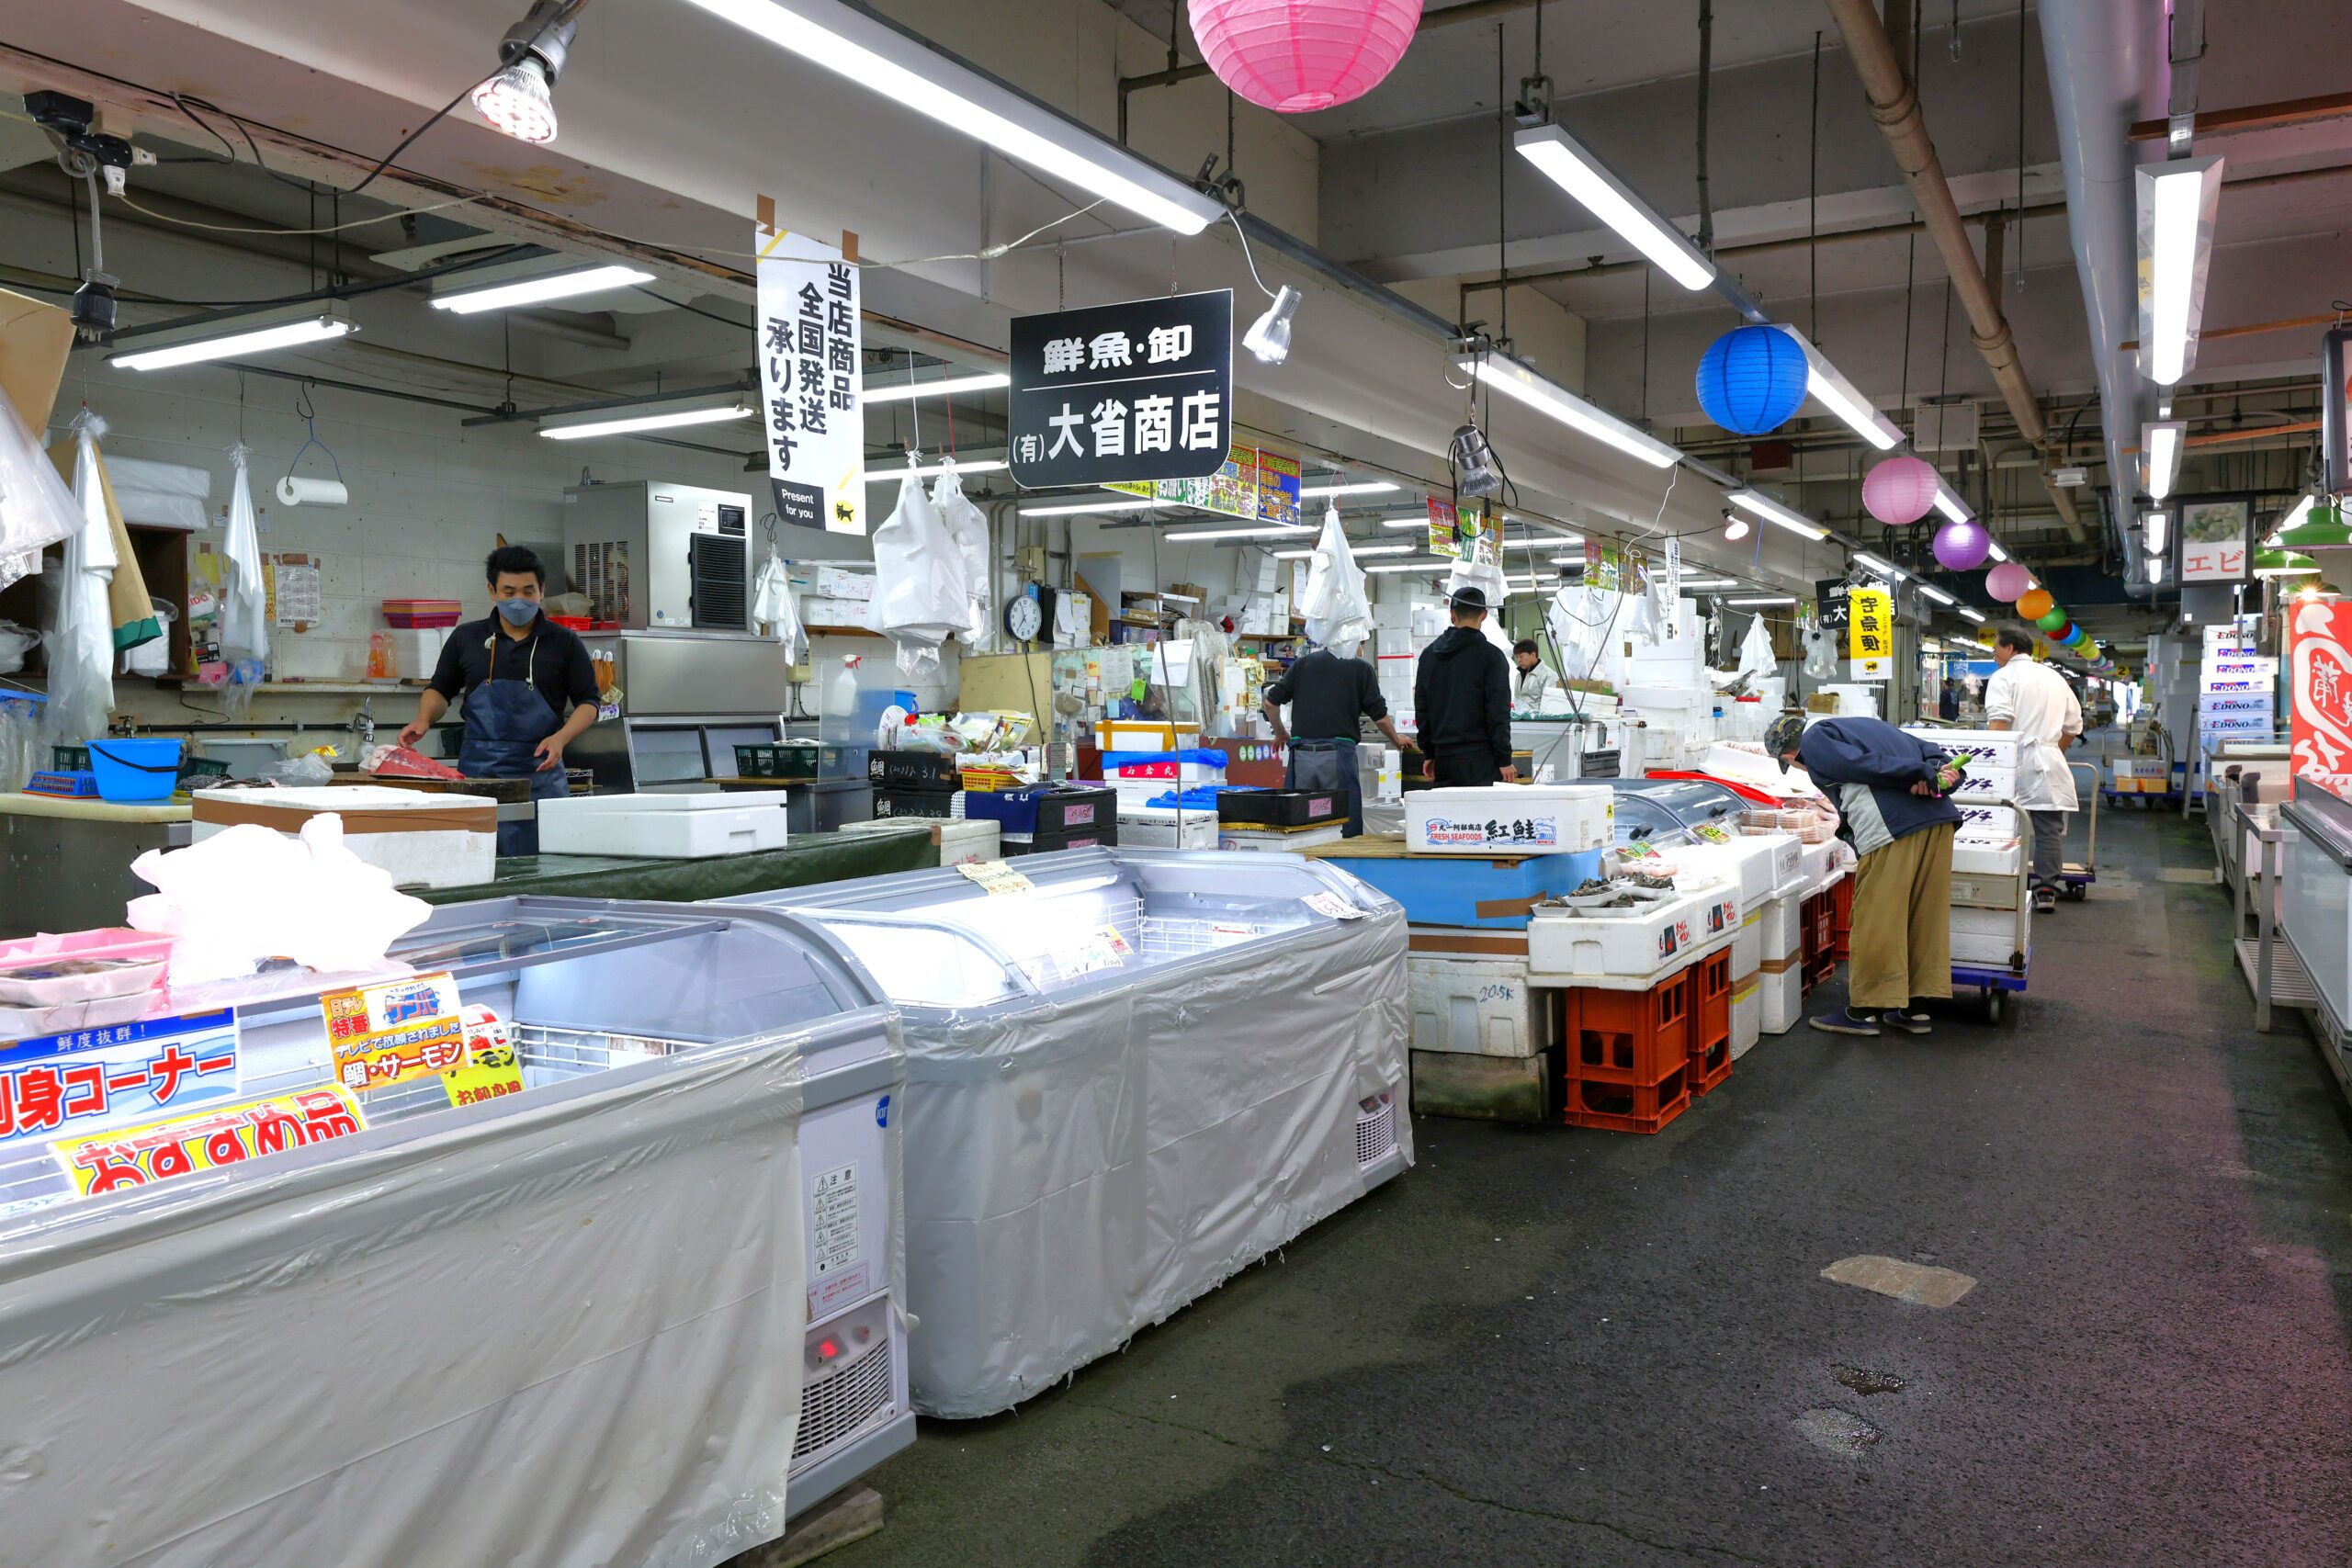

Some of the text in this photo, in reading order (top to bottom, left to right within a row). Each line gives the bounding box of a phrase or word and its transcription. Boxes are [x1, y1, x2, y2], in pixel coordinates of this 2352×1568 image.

[827, 263, 855, 412] 当店商品
[797, 282, 827, 435] 全国発送
[1043, 324, 1193, 375] 鮮魚・卸
[766, 317, 799, 472] 承ります
[781, 488, 815, 504] Present
[786, 503, 814, 519] for you
[2184, 549, 2244, 574] エビ
[2216, 631, 2254, 639] EDONO
[2118, 666, 2126, 675] 2
[2217, 665, 2256, 673] EDONO
[2211, 682, 2250, 692] EDONO
[2211, 702, 2250, 710] EDONO
[870, 757, 885, 777] 鯛
[1126, 764, 1173, 776] 石倉丸
[876, 797, 891, 817] 鯛
[1485, 819, 1536, 841] 紅鮭
[329, 995, 365, 1018] 日テレ
[331, 1012, 369, 1039] 特番
[335, 1021, 461, 1058] テレビで放映されました
[342, 1042, 463, 1088] 鯛・サーモン
[72, 1090, 360, 1196] おすすめ品
[830, 1169, 852, 1186] 注意
